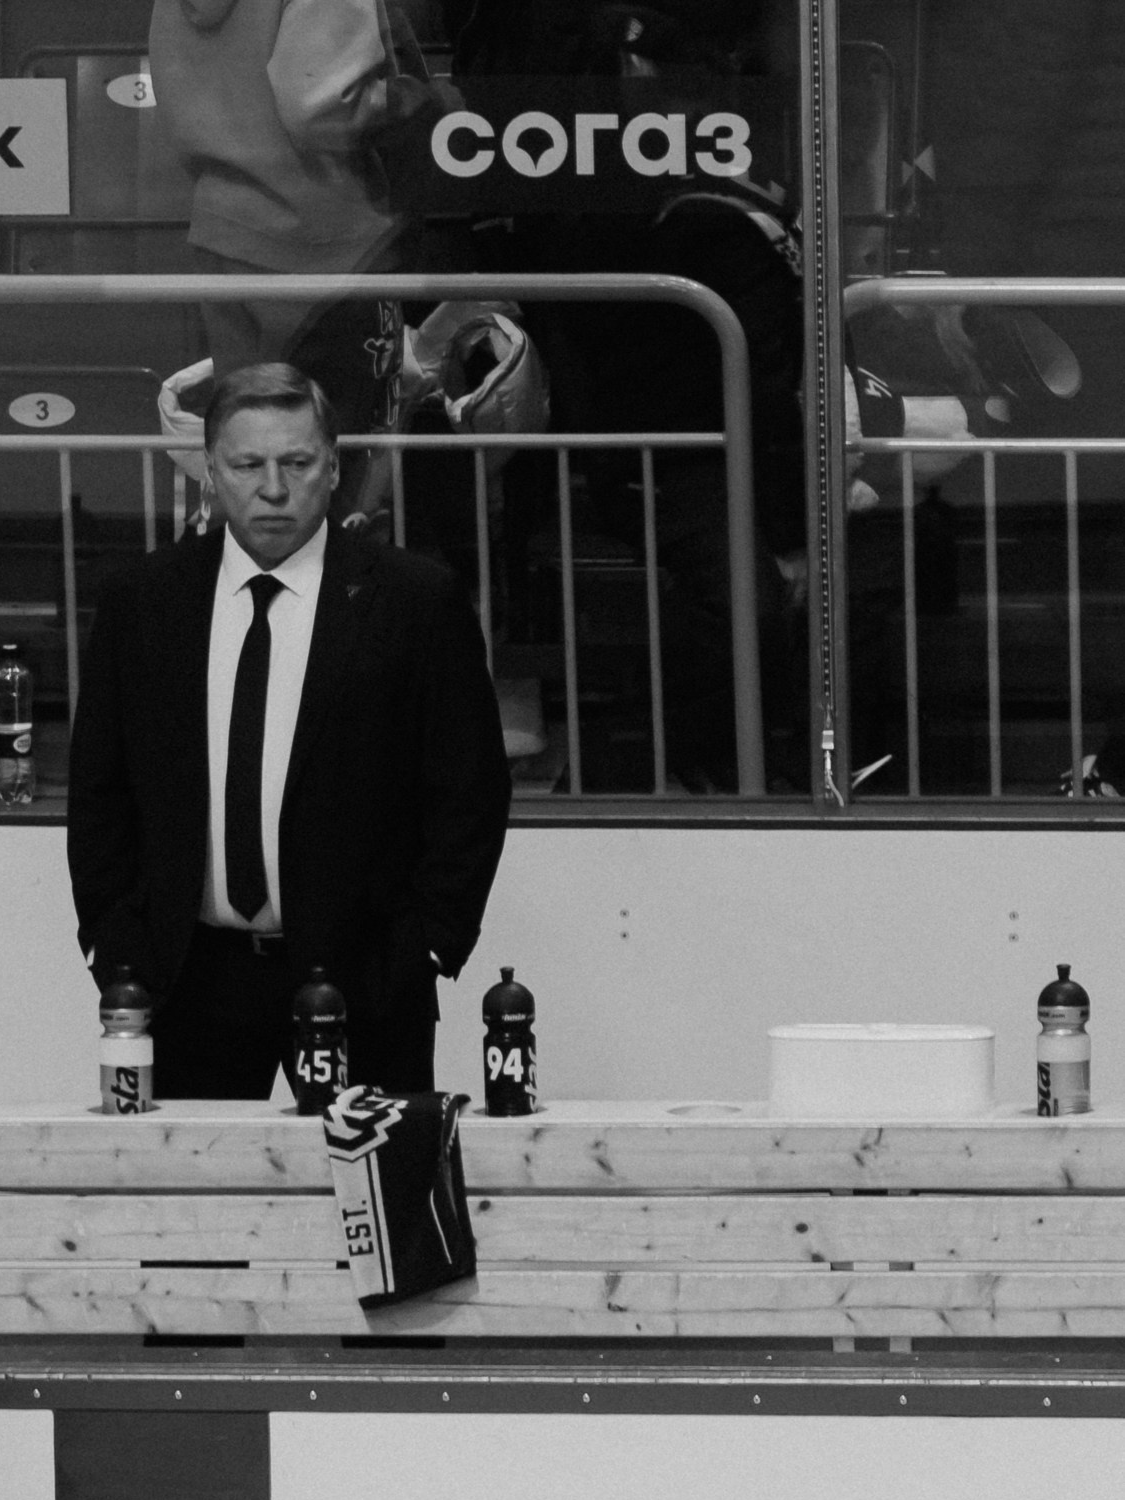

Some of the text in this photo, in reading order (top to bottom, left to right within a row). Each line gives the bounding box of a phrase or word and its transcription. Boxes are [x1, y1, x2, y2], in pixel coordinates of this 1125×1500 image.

[133, 79, 147, 102] 3
[35, 399, 50, 421] 3
[297, 1049, 332, 1083] 45
[487, 1046, 525, 1082] 94
[111, 1066, 140, 1115] sta
[342, 1199, 375, 1256] EST.
